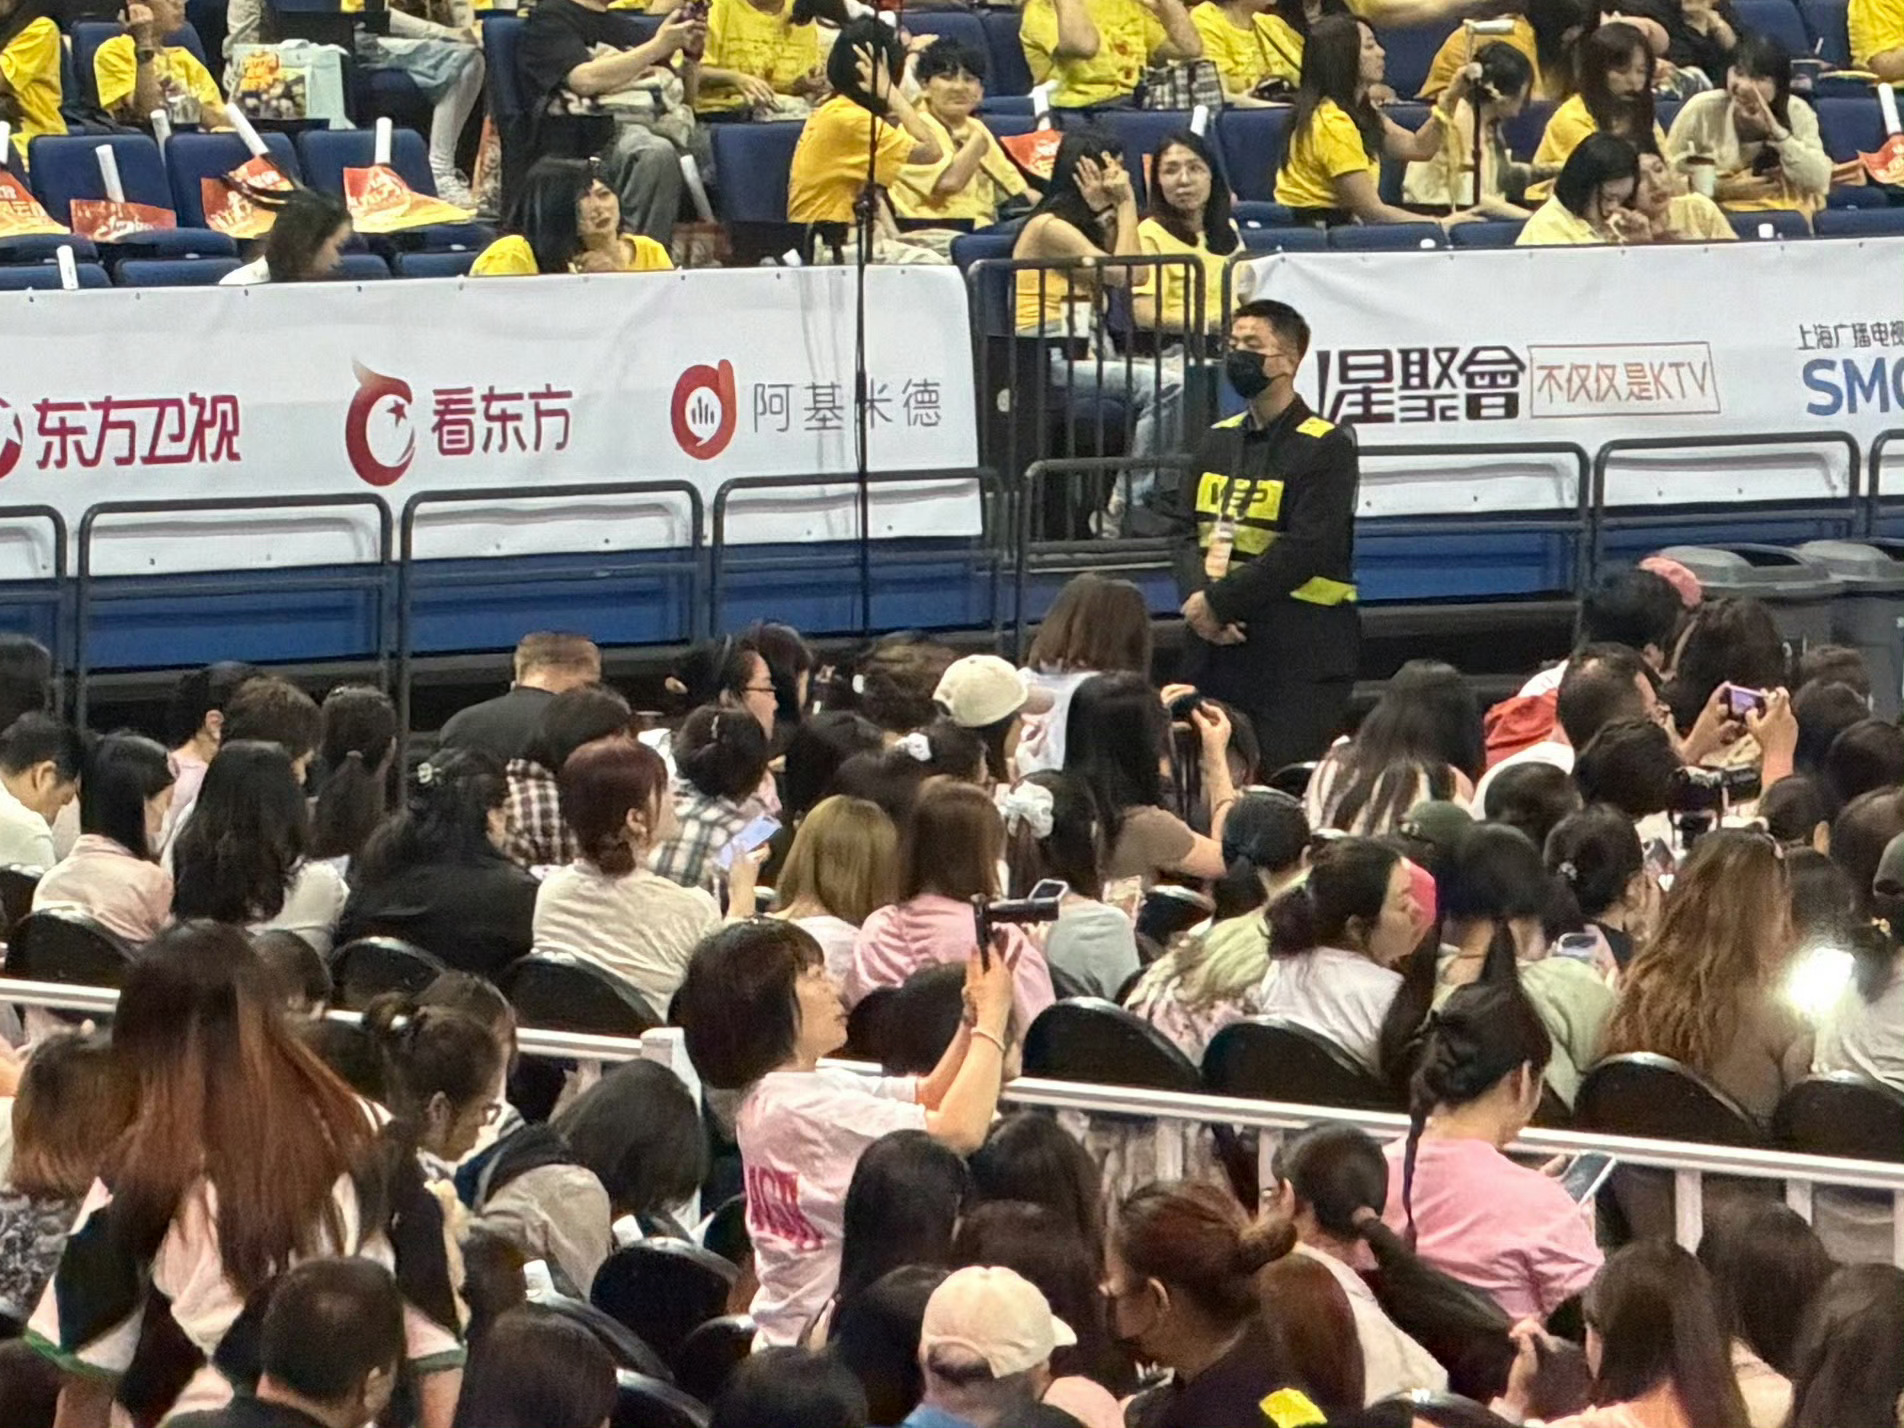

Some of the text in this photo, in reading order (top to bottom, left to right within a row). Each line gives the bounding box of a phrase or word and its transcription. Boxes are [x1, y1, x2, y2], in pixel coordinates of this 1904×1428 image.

[754, 378, 941, 432] 阿基米德
[1536, 360, 1708, 404] 不仅仅是KTV
[1802, 357, 1904, 416] SM
[33, 392, 241, 470] 东方卫视
[431, 383, 573, 456] 看东方
